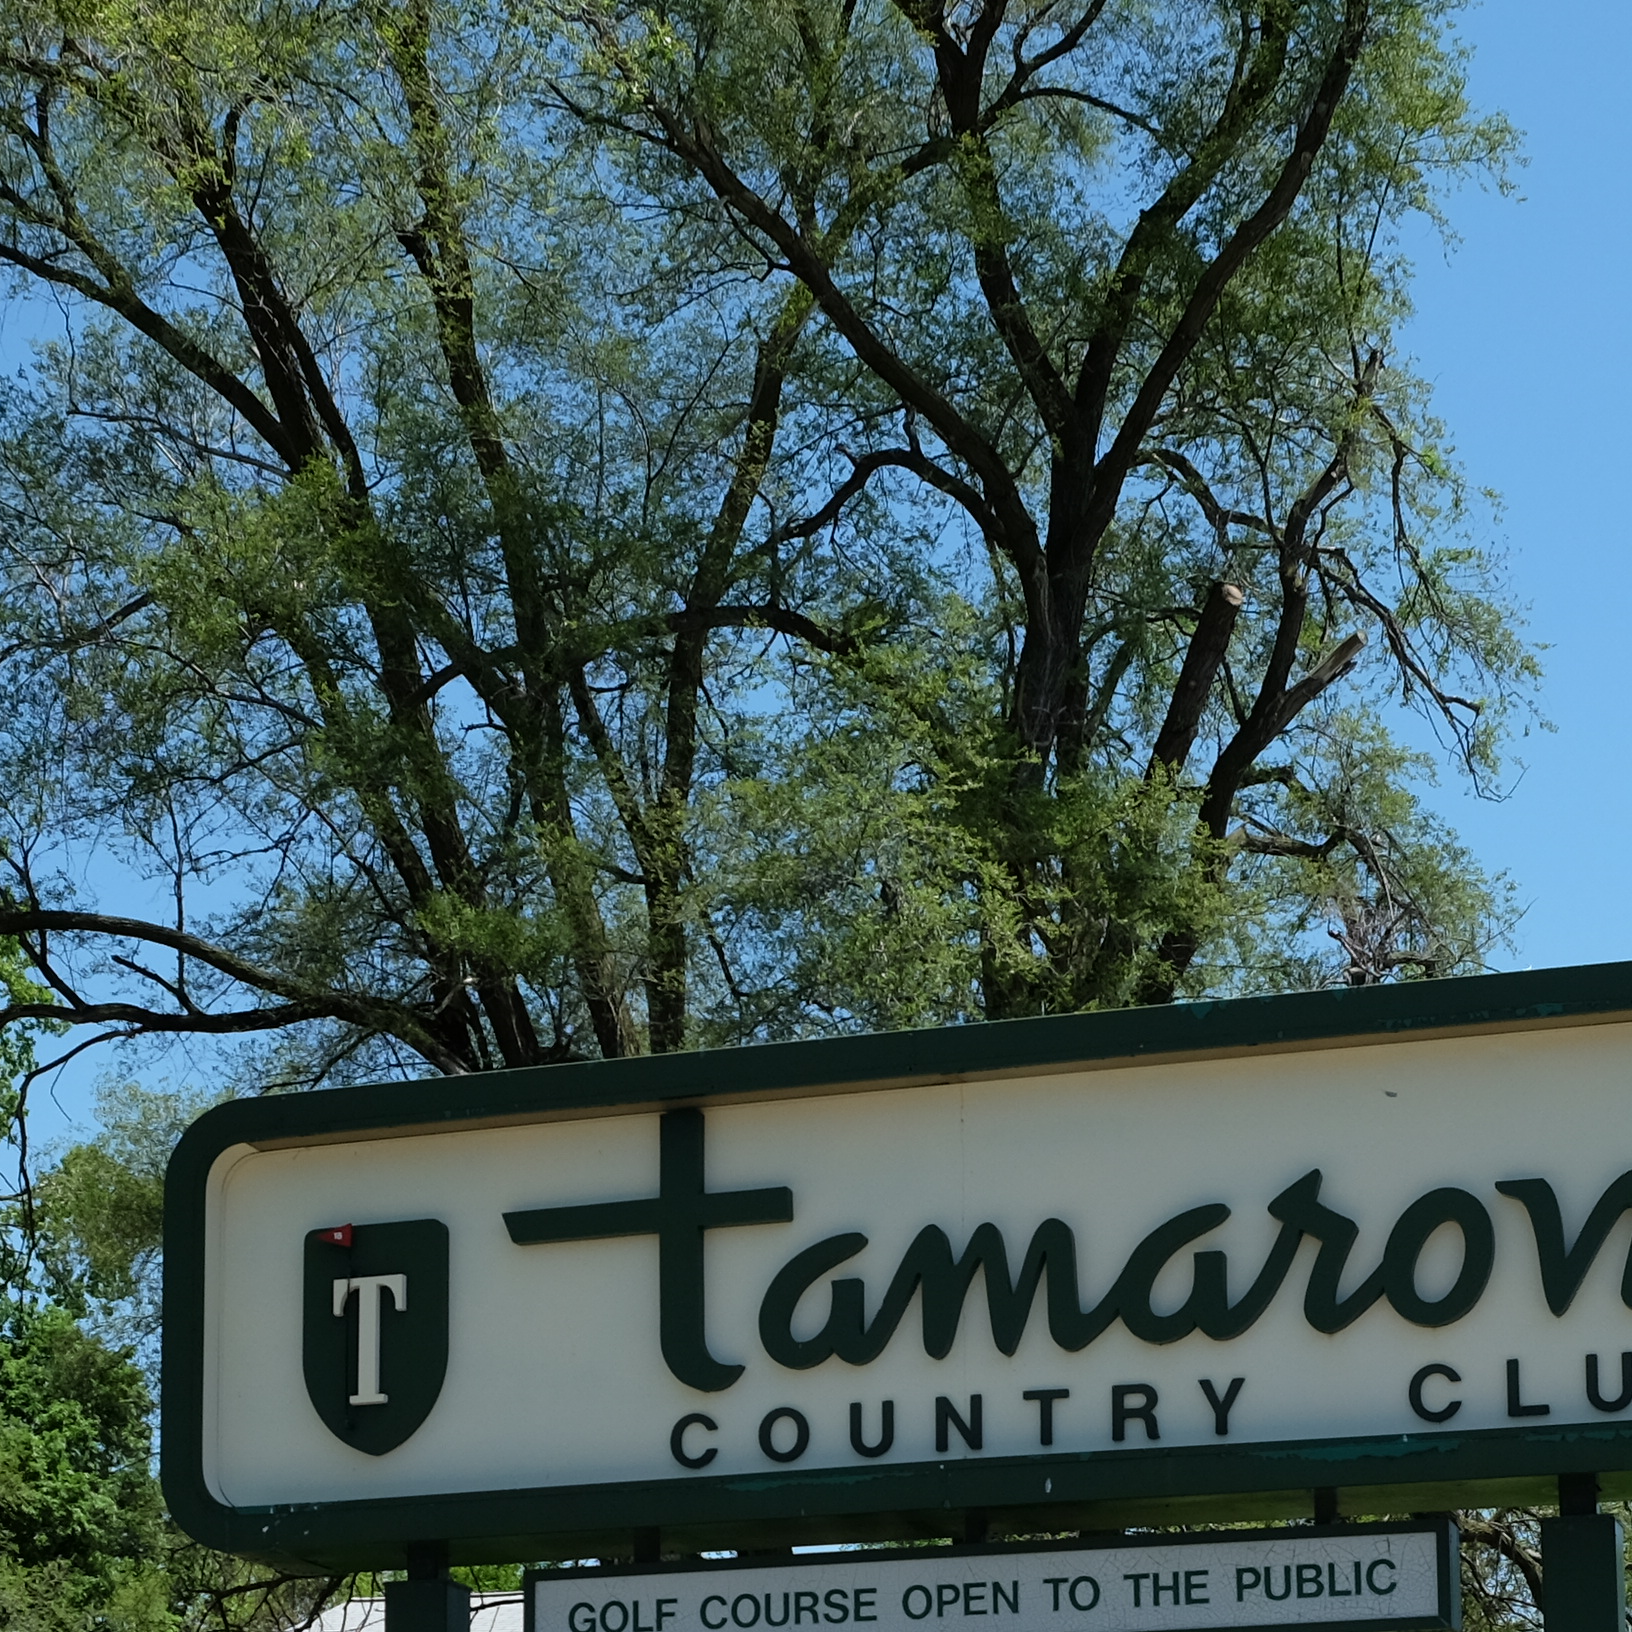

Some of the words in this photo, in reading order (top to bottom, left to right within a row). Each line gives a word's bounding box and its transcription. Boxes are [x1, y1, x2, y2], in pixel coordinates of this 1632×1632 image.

[332, 1273, 407, 1406] T
[670, 1377, 1246, 1469] COUNTRY
[699, 1587, 878, 1630] COURSE
[901, 1580, 1019, 1620] OPEN
[1043, 1575, 1101, 1612] TO
[1123, 1569, 1211, 1608] THE
[1235, 1558, 1397, 1602] PUBLIC
